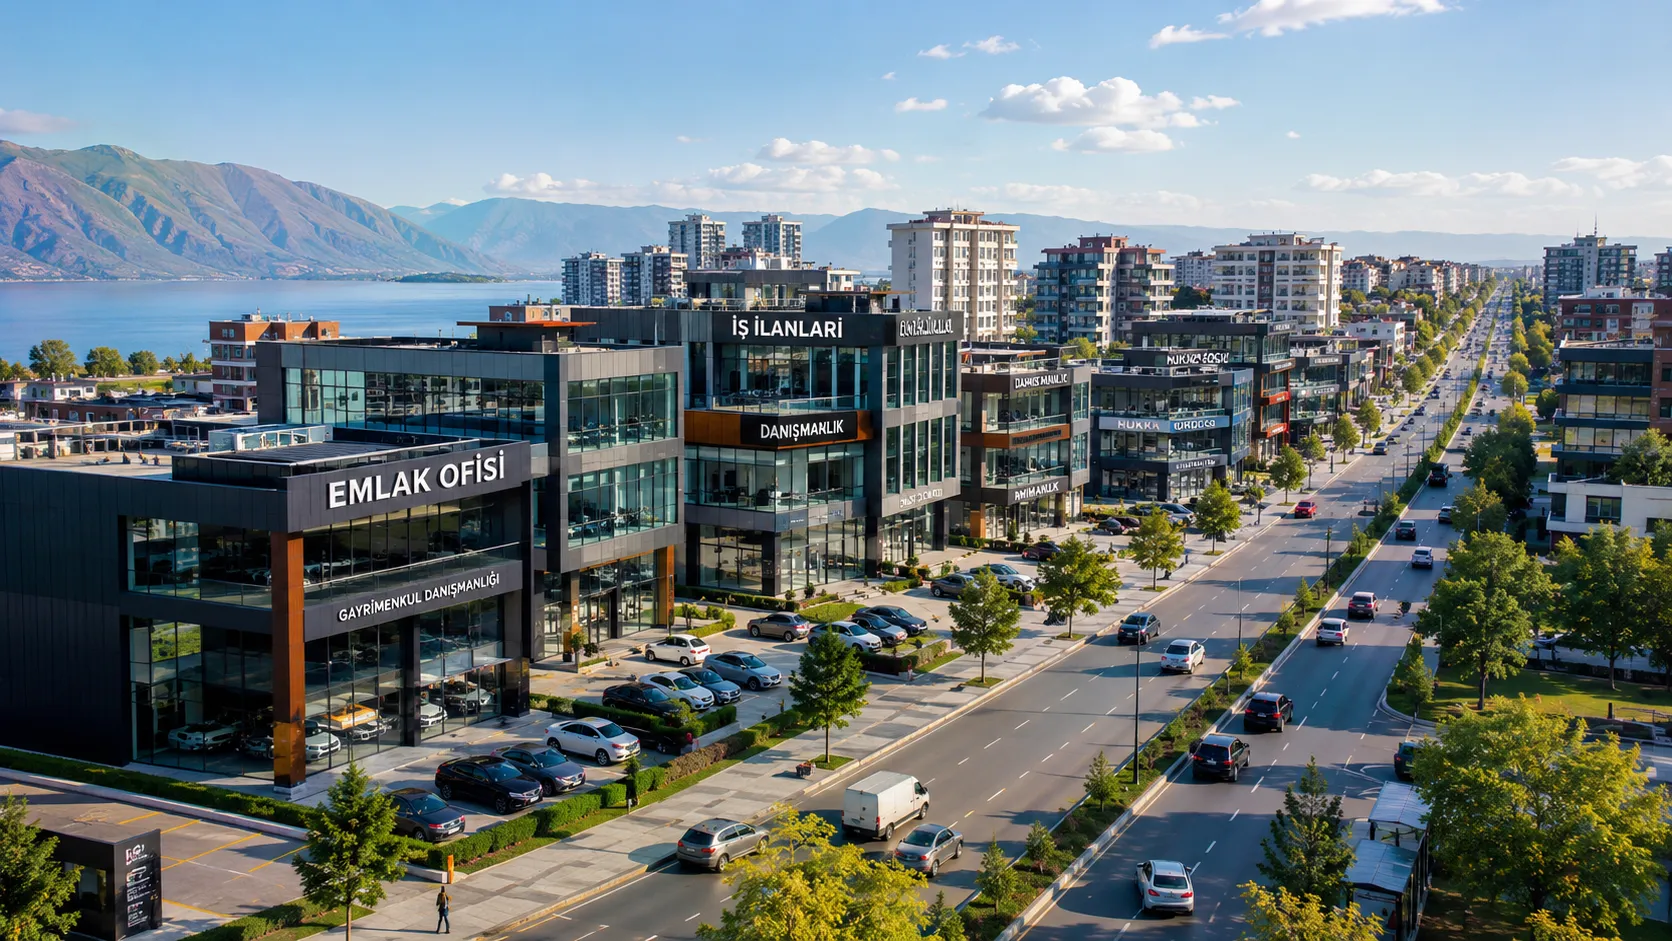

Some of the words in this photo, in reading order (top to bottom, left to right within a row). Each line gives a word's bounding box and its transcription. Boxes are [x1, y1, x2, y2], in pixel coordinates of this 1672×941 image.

[732, 314, 749, 340] İŞ
[754, 315, 843, 339] İLANLARİ
[328, 467, 432, 509] EMLAK
[439, 450, 505, 489] OFİSİ
[338, 592, 422, 622] GAYRİMENKUL
[424, 571, 500, 598] DANIŞMANLIĞI
